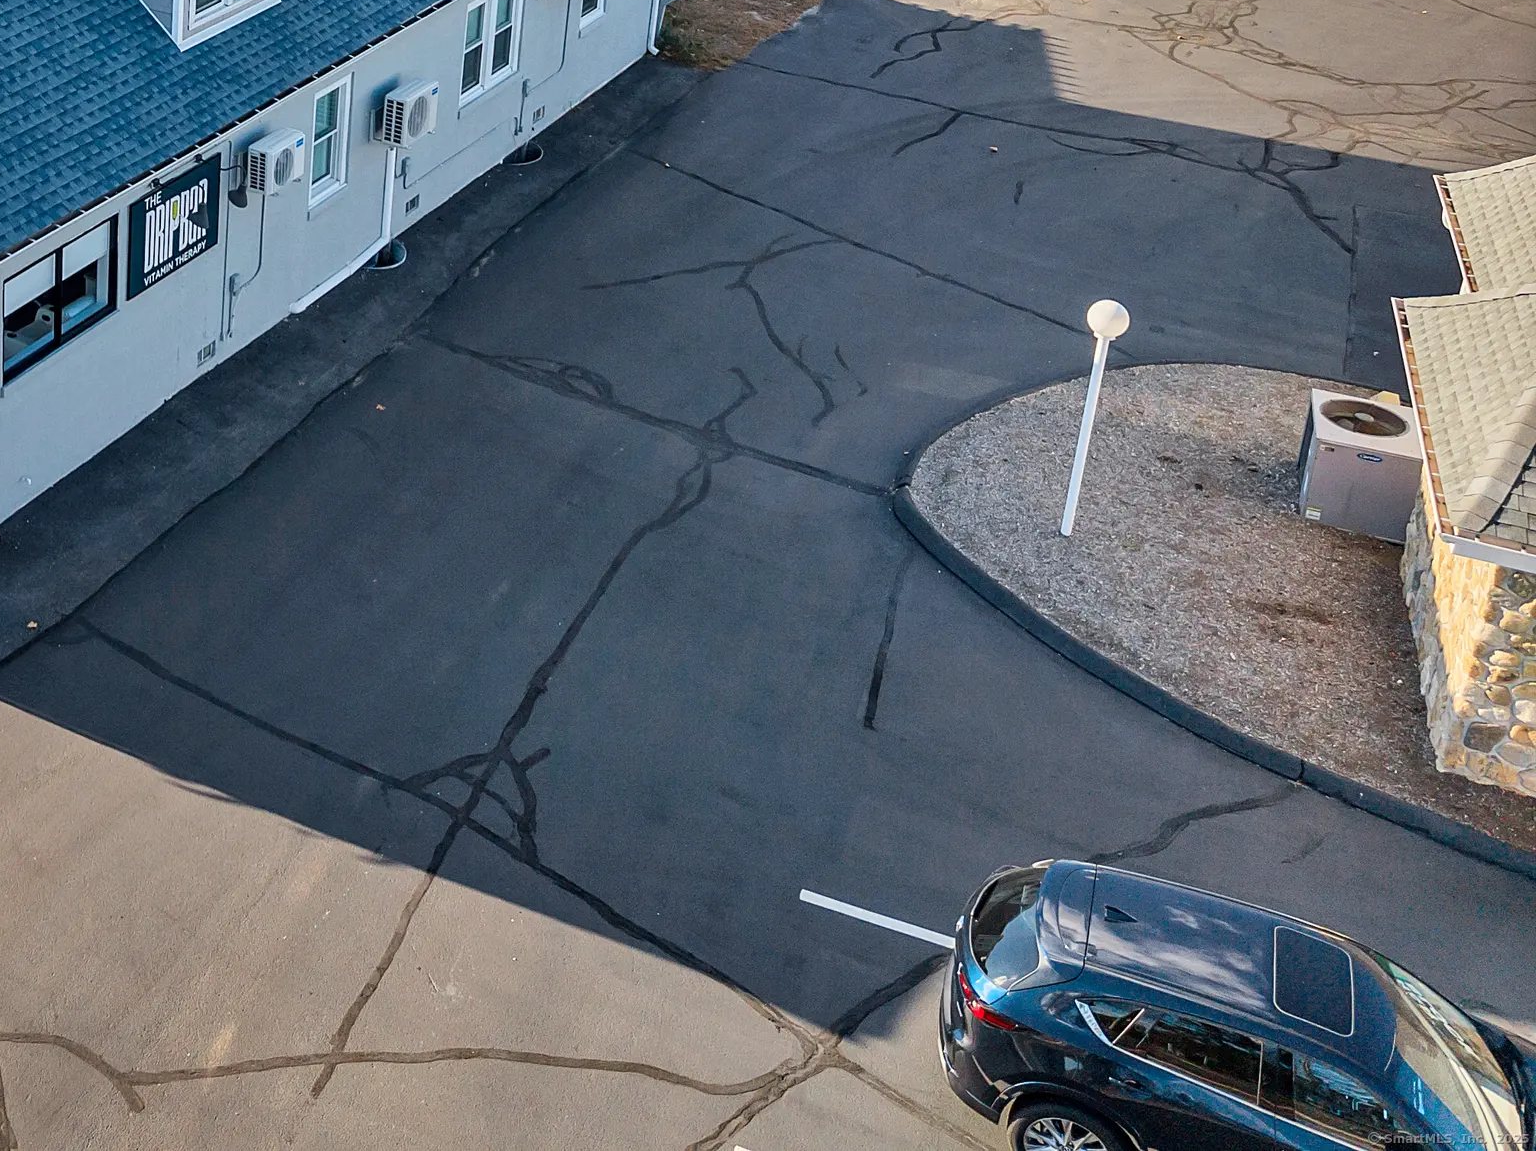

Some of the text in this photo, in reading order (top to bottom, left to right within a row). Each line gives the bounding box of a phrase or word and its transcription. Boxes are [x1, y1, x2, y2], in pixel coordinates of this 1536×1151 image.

[144, 190, 162, 210] THE
[144, 239, 207, 287] VITAMIN THERAPY
